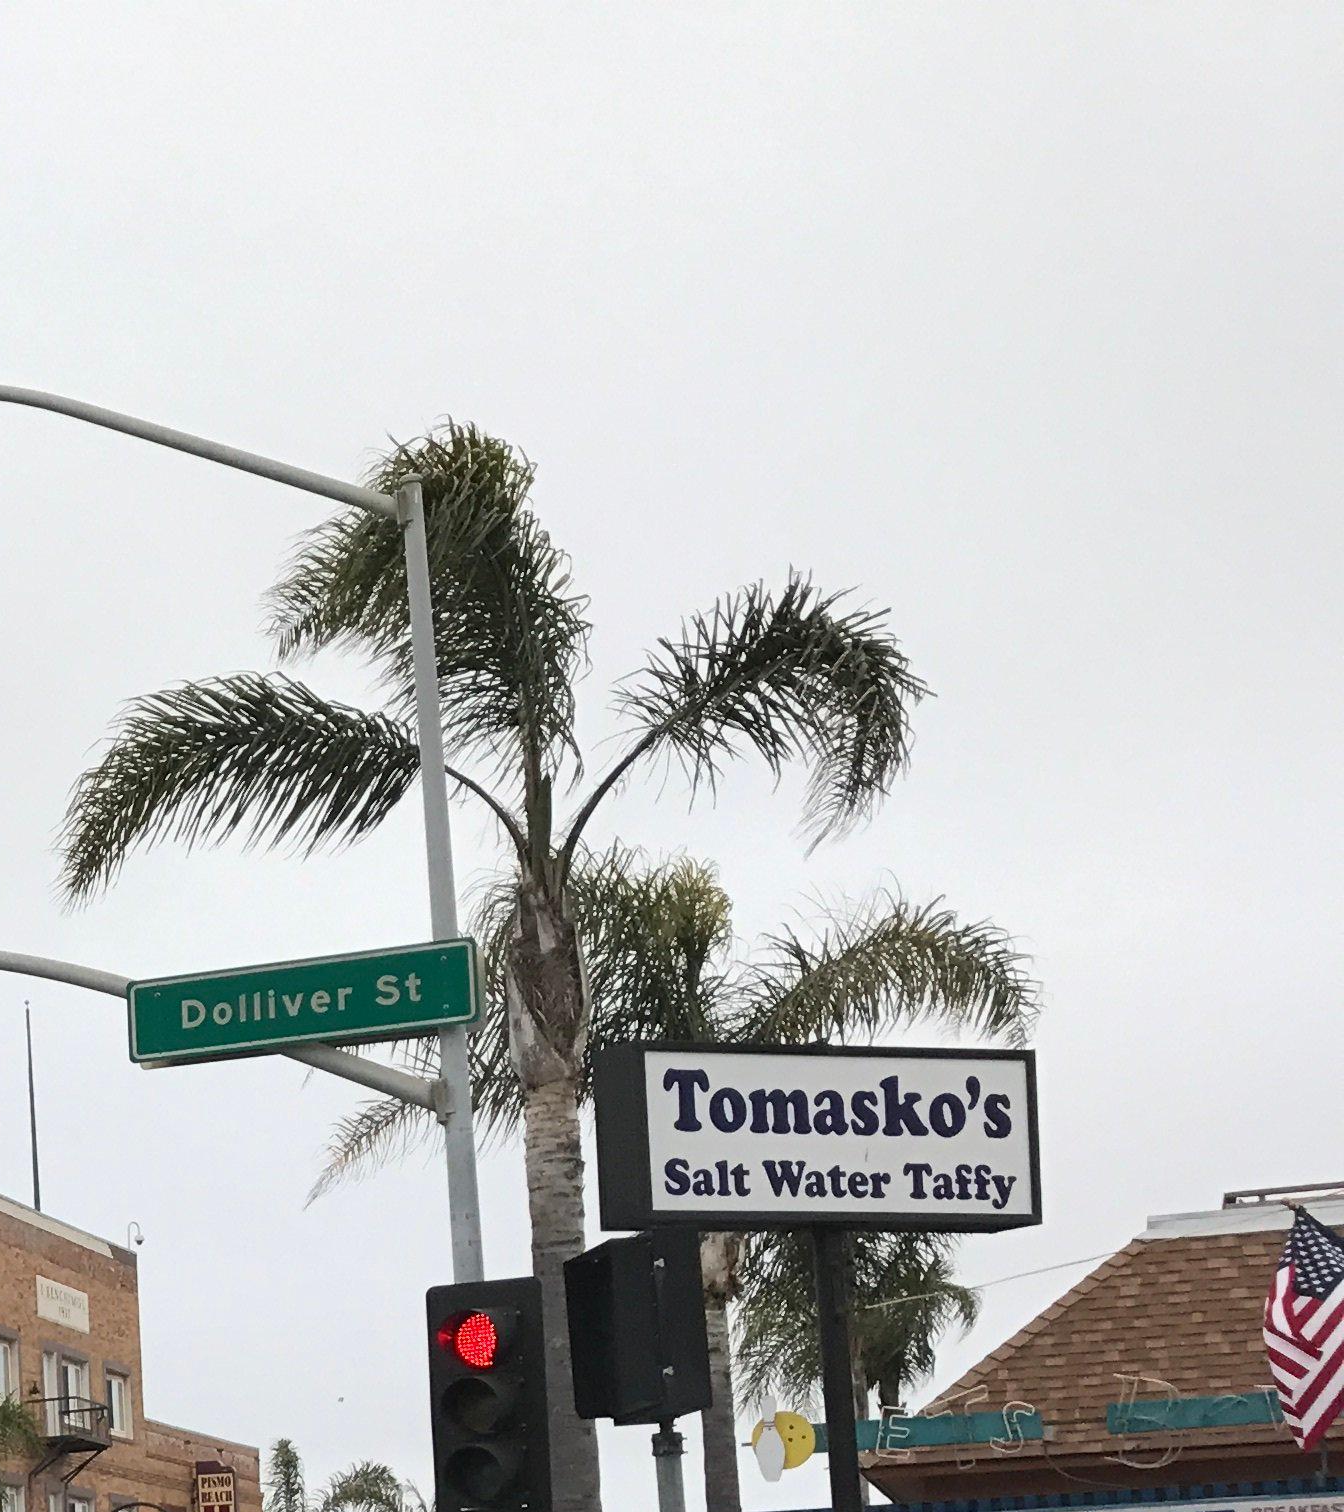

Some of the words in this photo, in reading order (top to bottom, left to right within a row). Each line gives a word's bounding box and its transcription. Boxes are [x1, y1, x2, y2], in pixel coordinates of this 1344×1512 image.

[181, 986, 353, 1029] Dolliver
[375, 972, 422, 1006] St
[663, 1068, 1012, 1139] Tomasko's
[664, 1157, 751, 1197] Salt
[762, 1159, 891, 1198] Water
[903, 1162, 1017, 1209] Taffy
[201, 1475, 231, 1488] PISMO
[202, 1489, 233, 1503] BEACH
